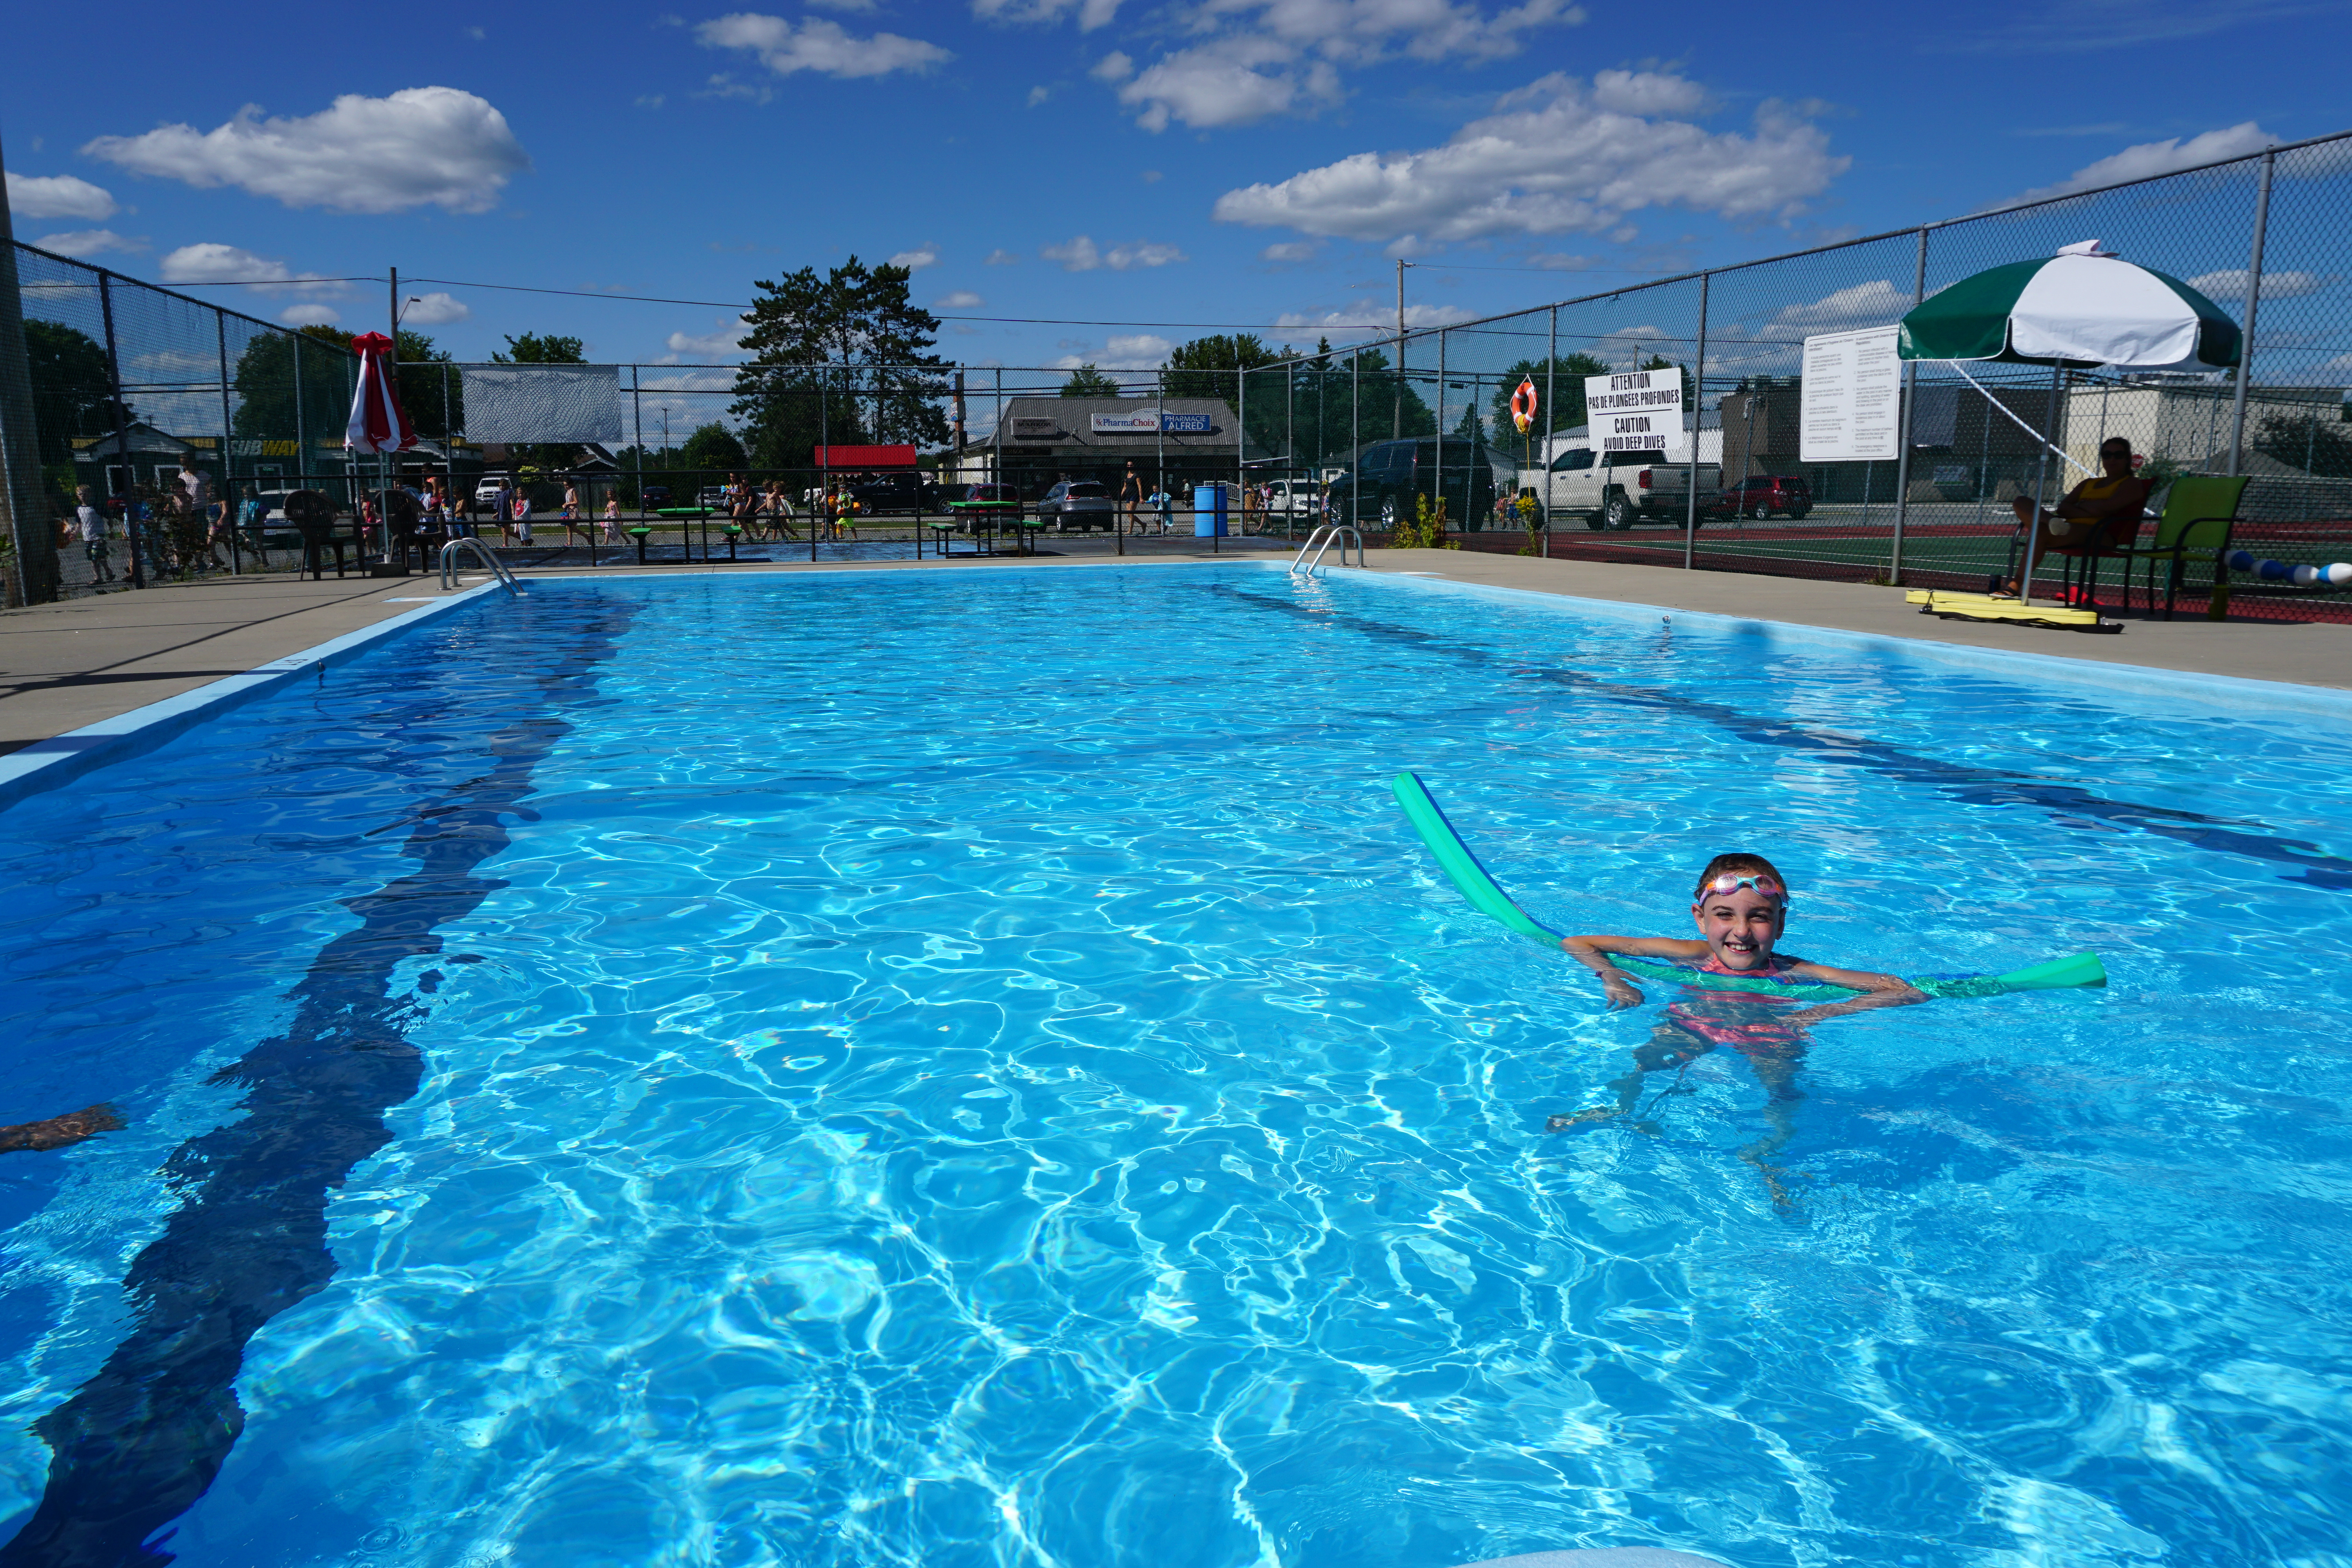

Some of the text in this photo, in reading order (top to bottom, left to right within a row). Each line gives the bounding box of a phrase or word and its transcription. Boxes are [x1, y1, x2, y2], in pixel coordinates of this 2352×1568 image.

[1611, 372, 1650, 391] ATTENTION
[1589, 389, 1679, 409] PAS DE PLONGÉES PROFONDES
[1168, 422, 1204, 430] ALFRED
[1615, 416, 1650, 433] CAUTION
[230, 440, 299, 456] SUBWAY
[1604, 435, 1665, 450] AVOID DEEP DIVES
